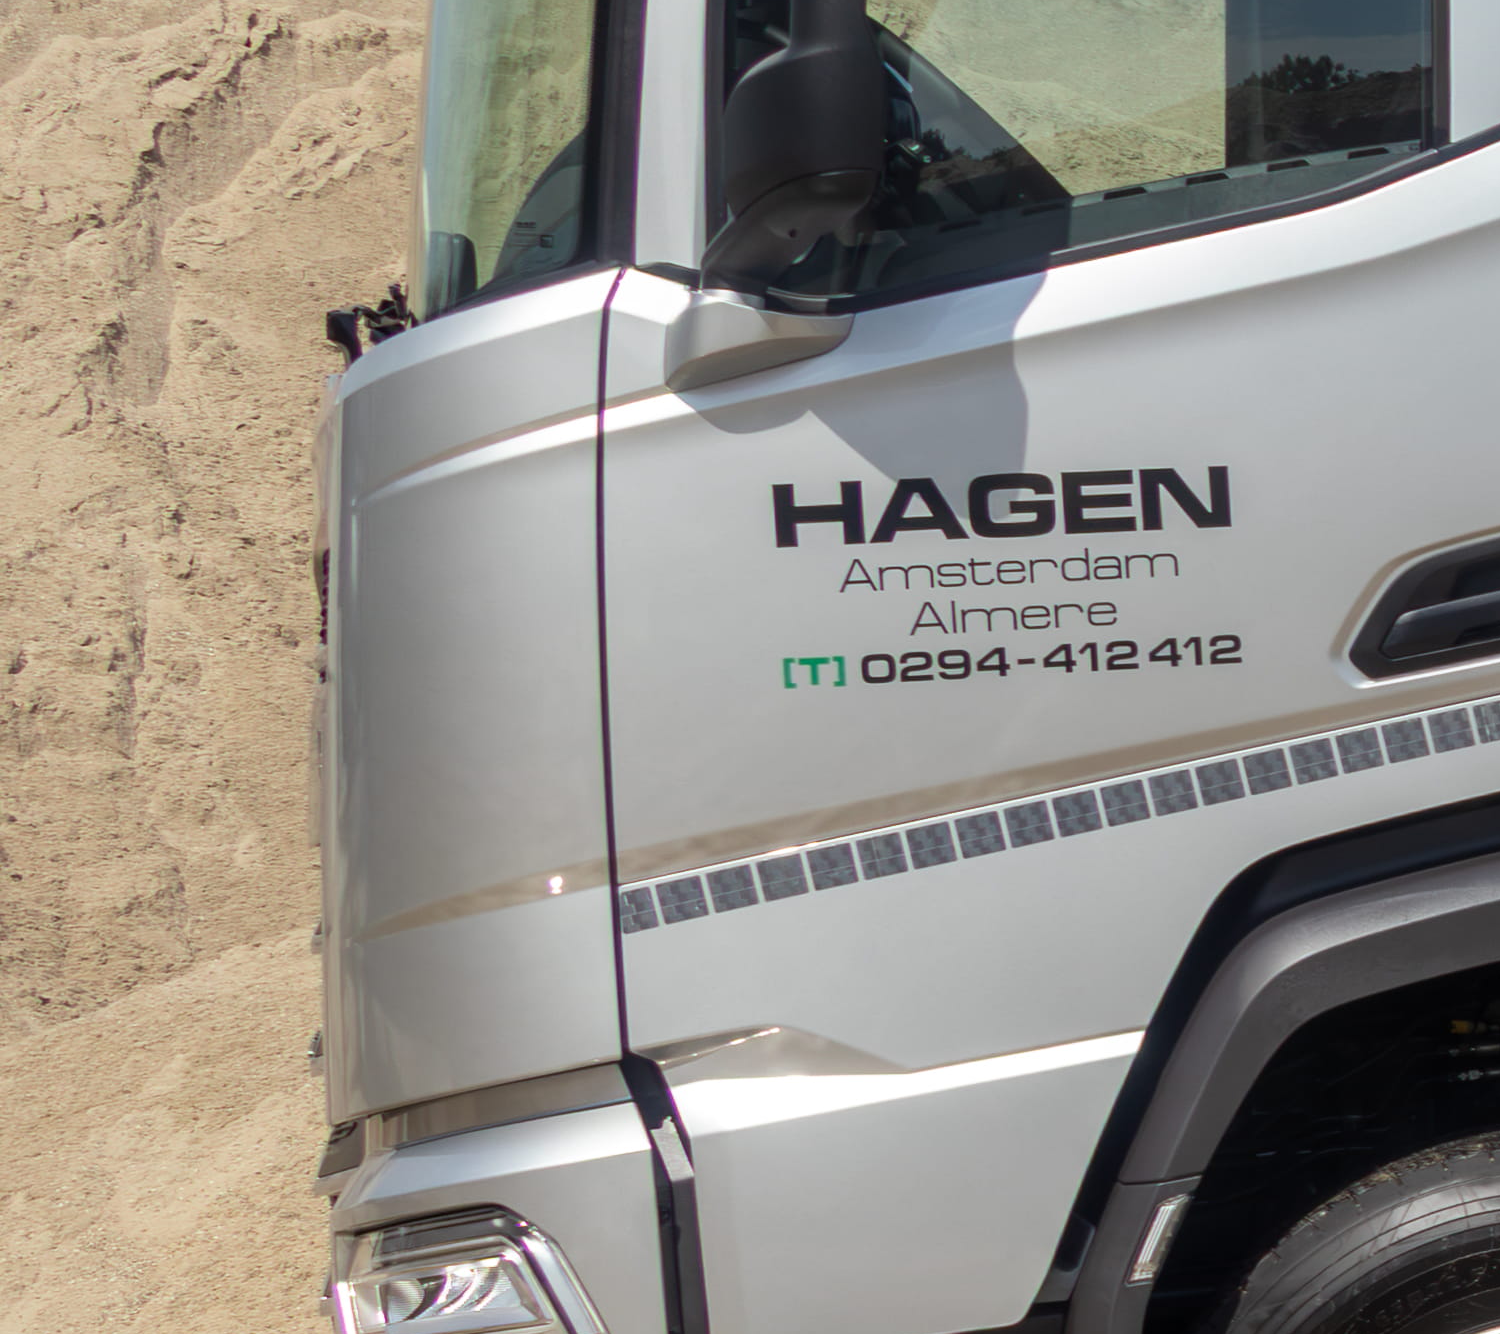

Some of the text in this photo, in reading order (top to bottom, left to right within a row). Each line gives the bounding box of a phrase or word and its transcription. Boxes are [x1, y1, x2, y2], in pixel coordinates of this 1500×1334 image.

[771, 466, 1232, 548] HAGEN
[840, 548, 1179, 593] Amsterdam
[910, 601, 1118, 636] Almere
